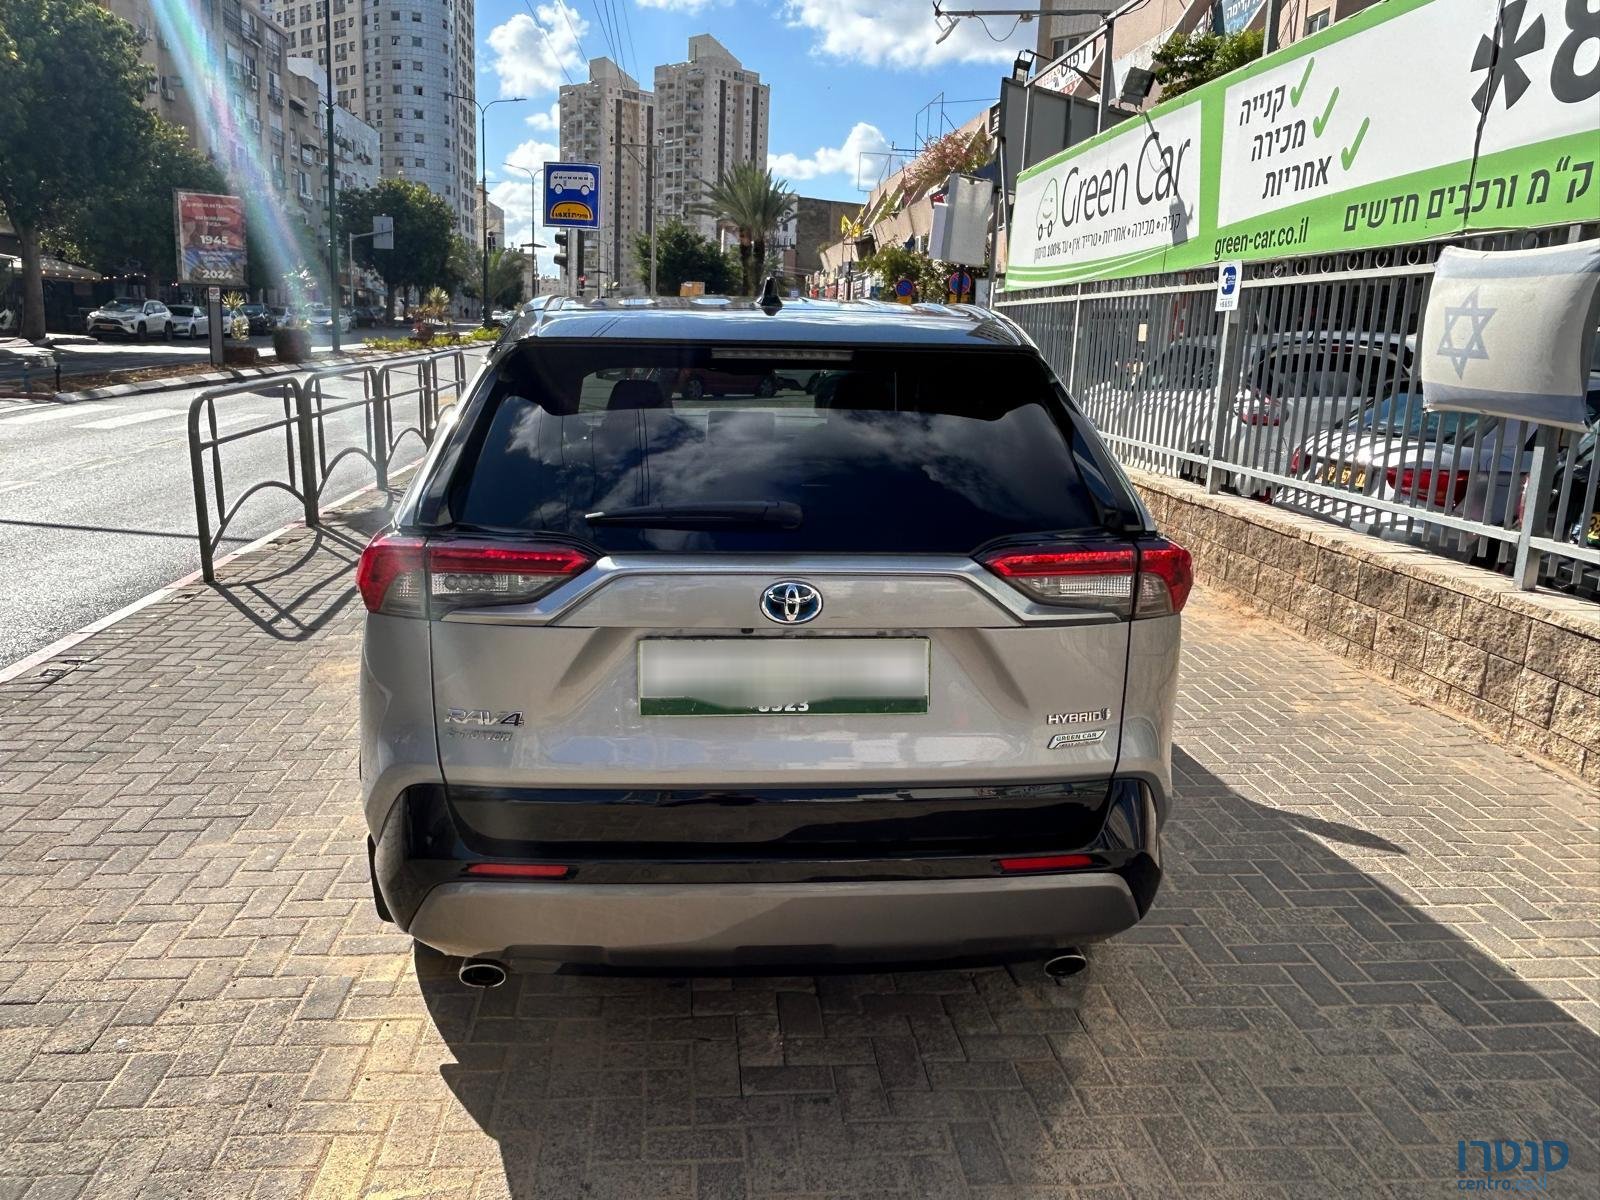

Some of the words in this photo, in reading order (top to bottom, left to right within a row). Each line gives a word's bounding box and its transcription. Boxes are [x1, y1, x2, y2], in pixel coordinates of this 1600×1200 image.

[1239, 84, 1287, 127] קנייה
[1251, 119, 1306, 162] מכירה
[1061, 162, 1129, 228] Green
[1136, 131, 1191, 206] Car
[1262, 156, 1333, 200] אחריות
[1426, 174, 1519, 220] ורכבים
[1160, 212, 1181, 232] קניה
[1343, 193, 1420, 233] חדשים
[200, 234, 229, 245] 1945
[1102, 225, 1127, 246] אחריות
[1131, 219, 1156, 239] מכירה
[1214, 216, 1309, 261] green-car.co.il
[202, 269, 233, 279] 2024
[444, 708, 525, 726] RAV4
[1047, 710, 1101, 725] HYBRID
[1056, 733, 1081, 742] GREEN
[1082, 732, 1097, 740] CAR
